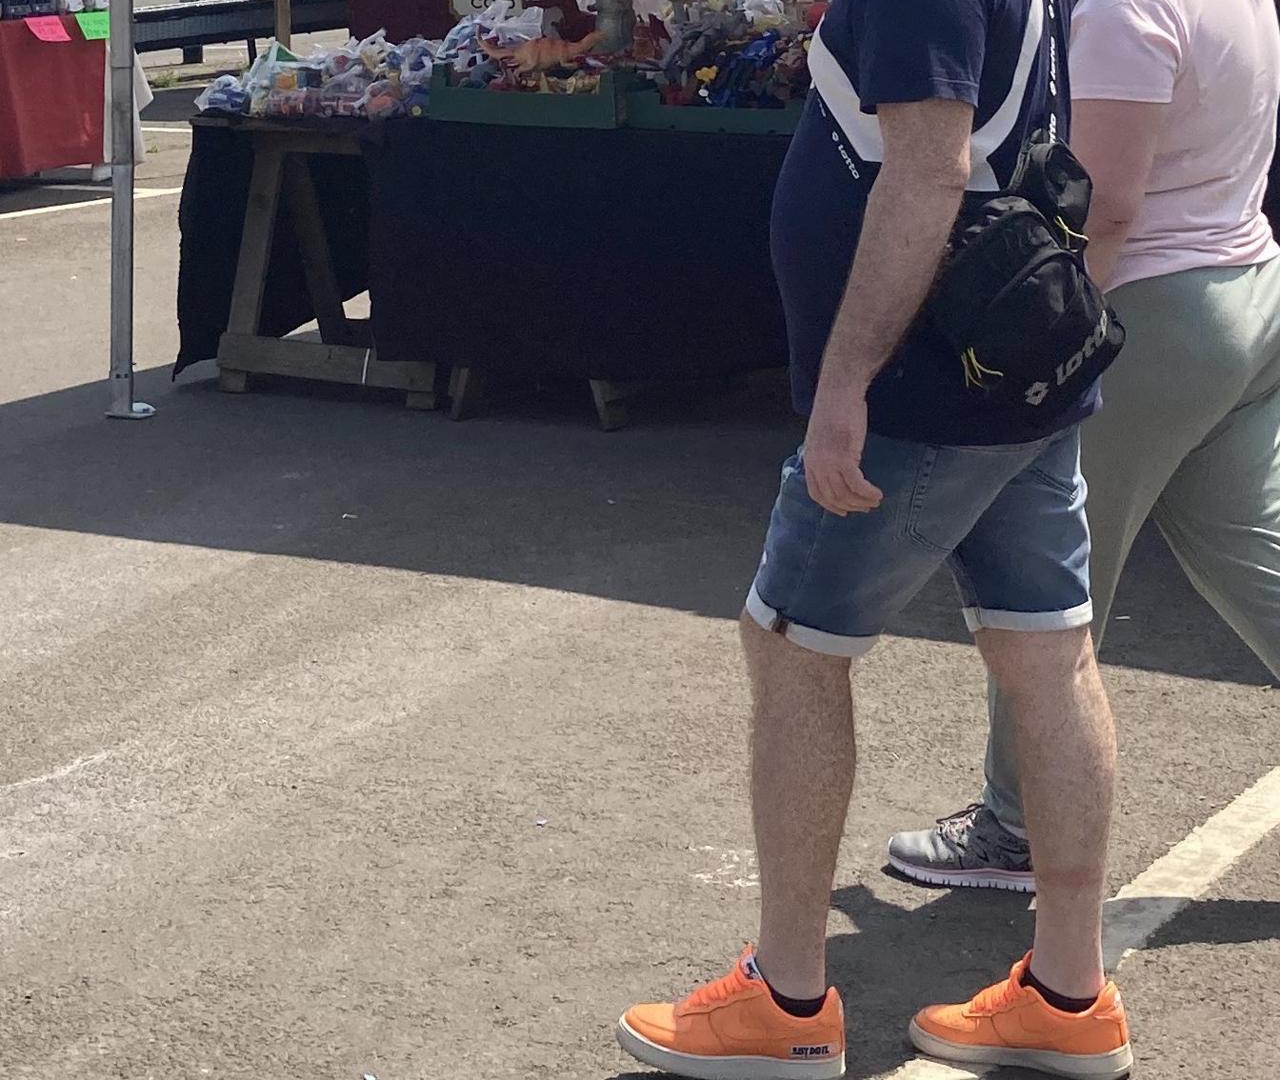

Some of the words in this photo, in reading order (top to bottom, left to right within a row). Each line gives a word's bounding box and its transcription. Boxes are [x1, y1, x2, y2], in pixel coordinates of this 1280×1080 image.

[792, 1047, 809, 1057] JUST
[810, 1047, 821, 1055] DO
[821, 1045, 830, 1054] IT
